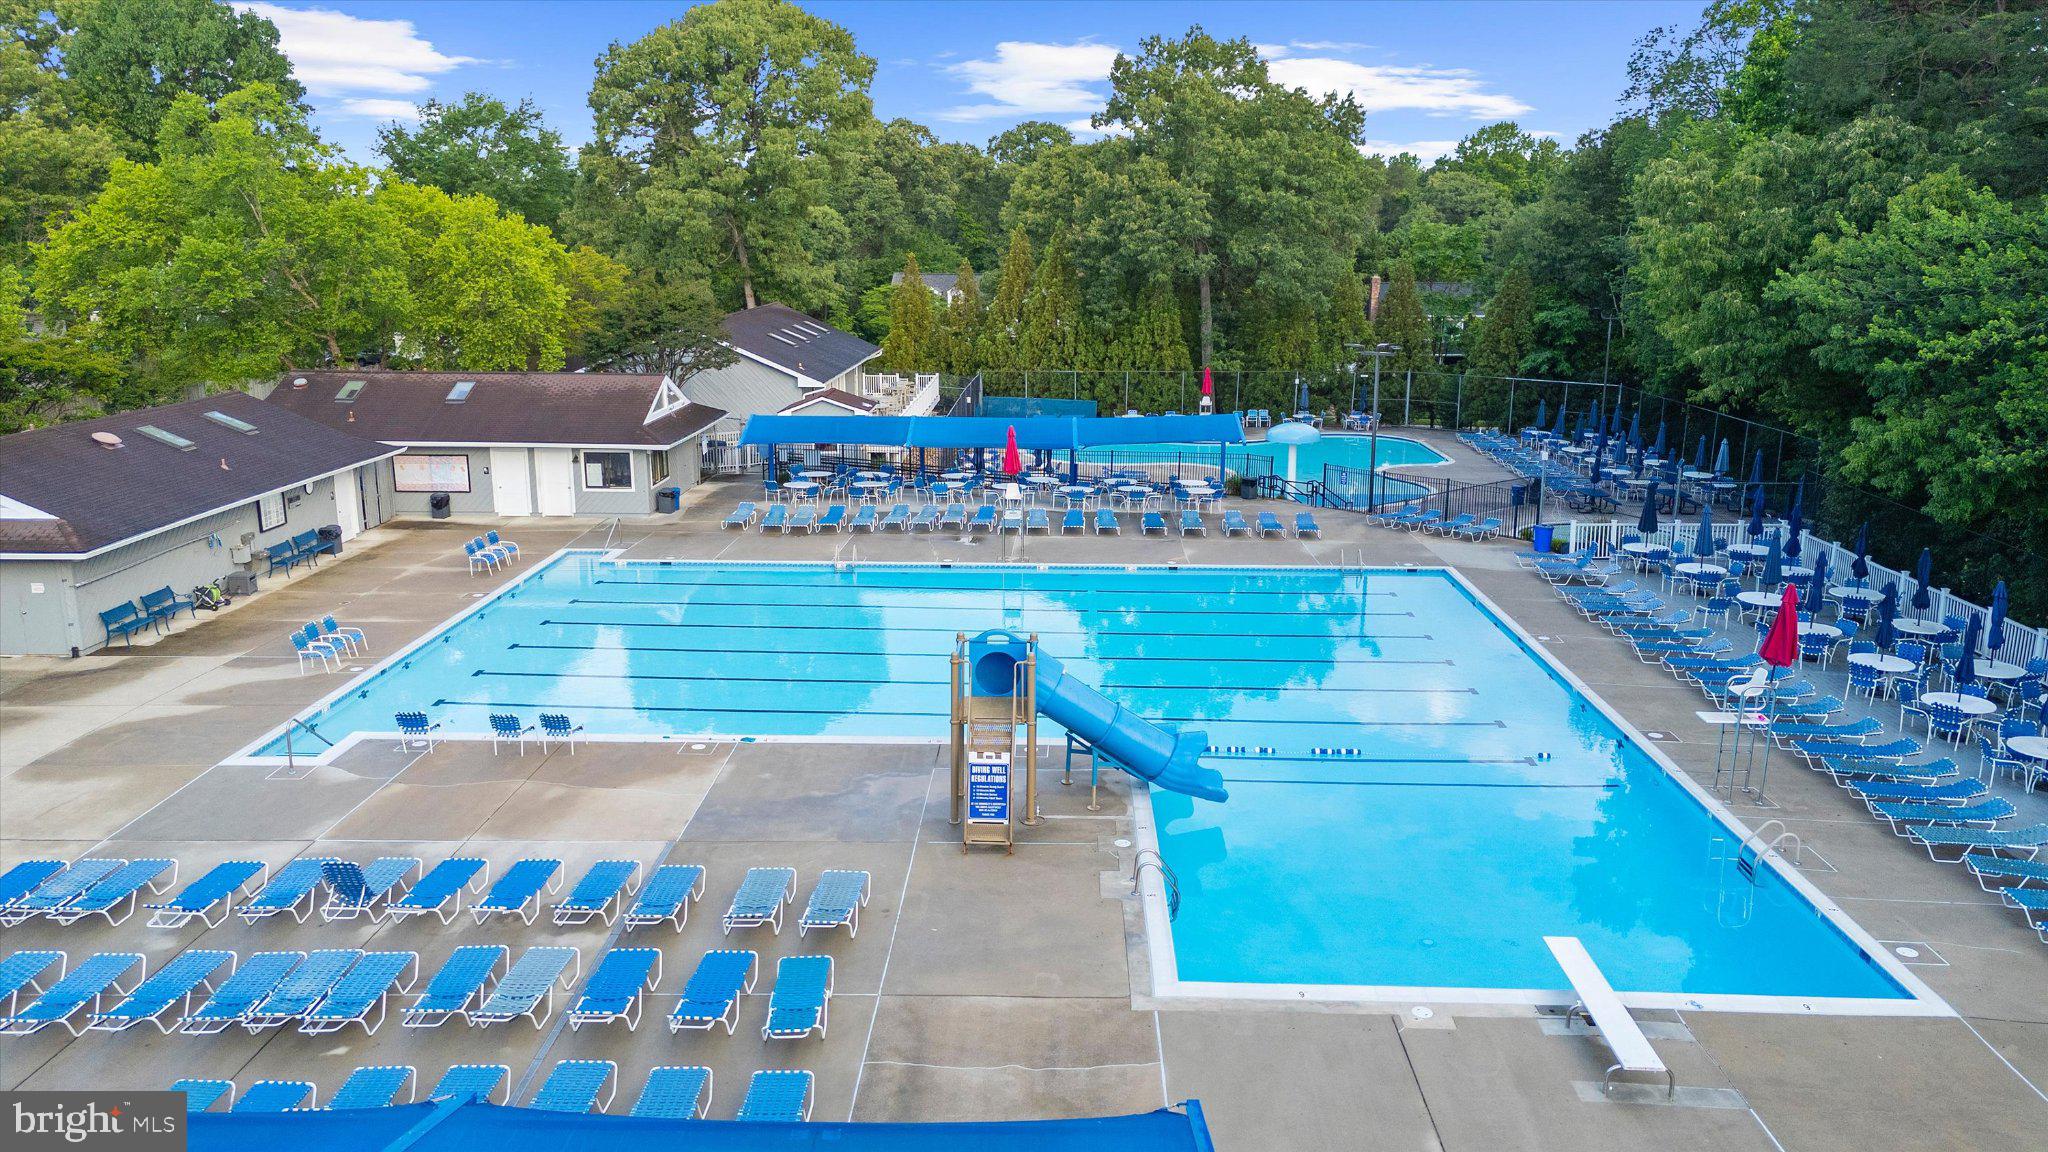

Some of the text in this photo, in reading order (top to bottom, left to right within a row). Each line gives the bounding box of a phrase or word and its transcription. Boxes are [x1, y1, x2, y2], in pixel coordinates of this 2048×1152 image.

[972, 766, 1006, 774] DIVING WELL
[971, 775, 1006, 783] REGULATIONS
